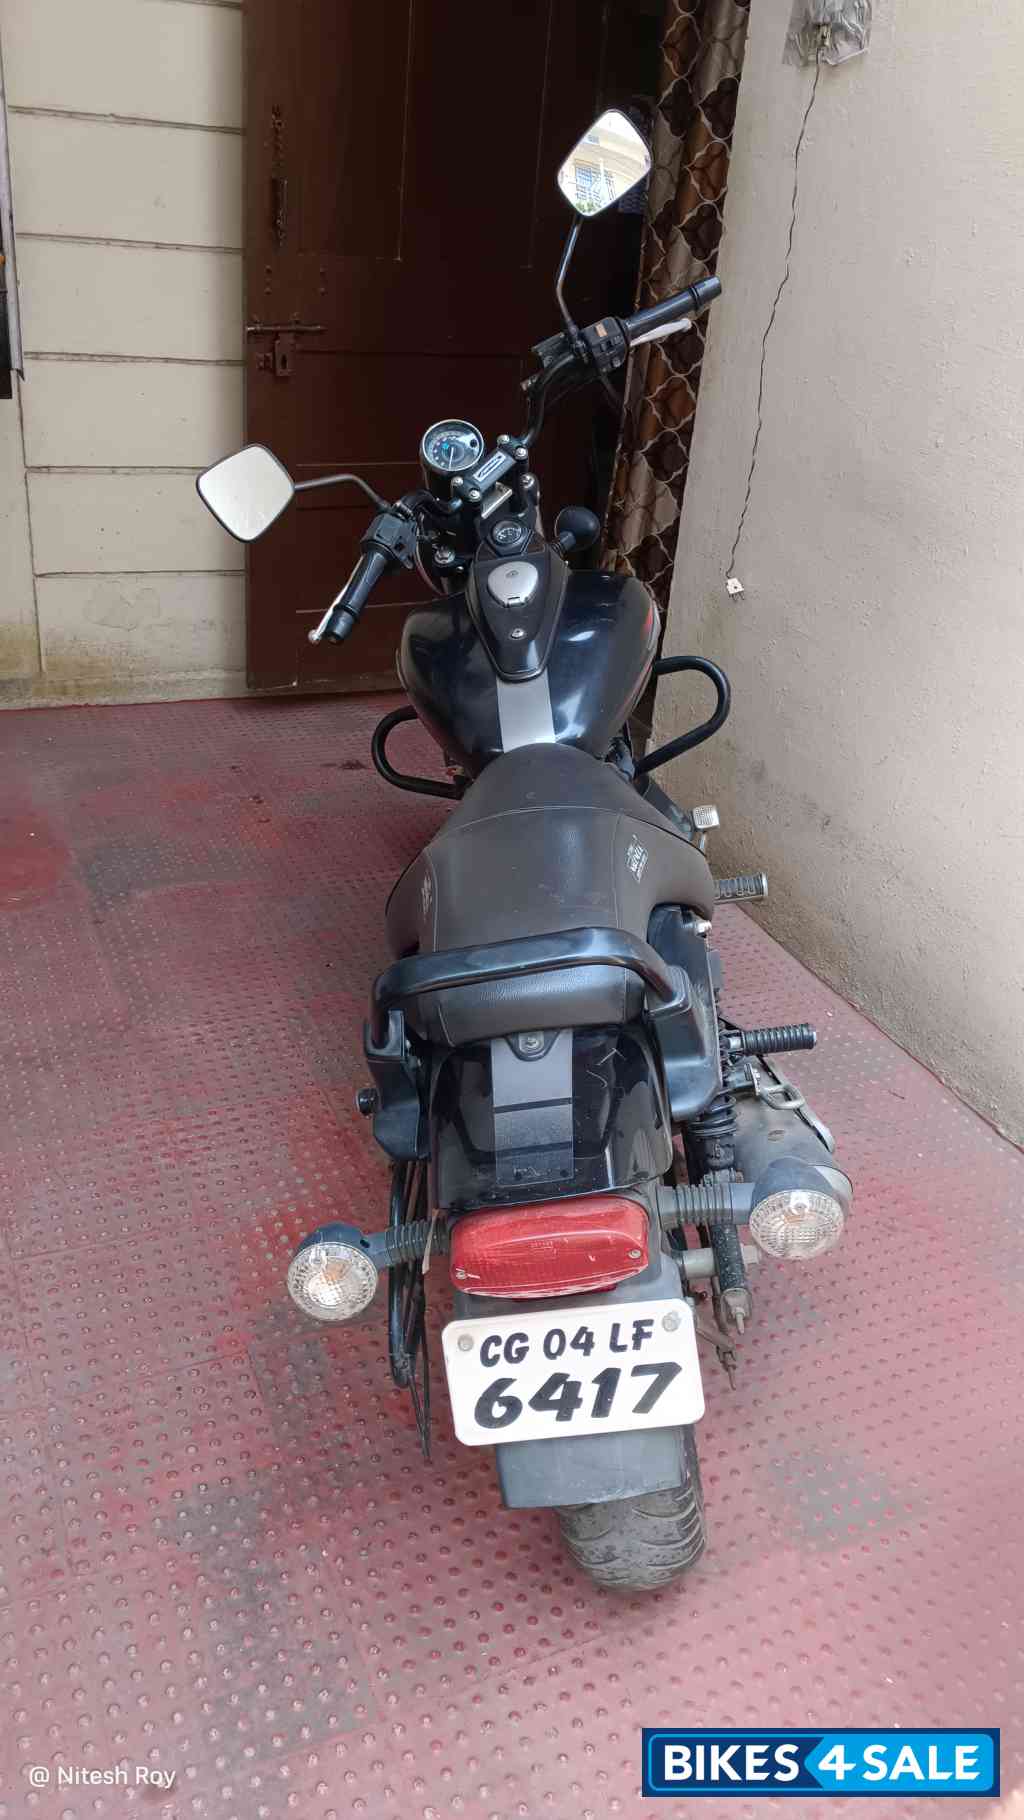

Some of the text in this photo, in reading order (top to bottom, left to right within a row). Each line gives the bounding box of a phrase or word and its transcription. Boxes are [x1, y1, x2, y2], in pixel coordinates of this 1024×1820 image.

[480, 1318, 655, 1368] CG 04 LF
[473, 1361, 683, 1430] 6417
